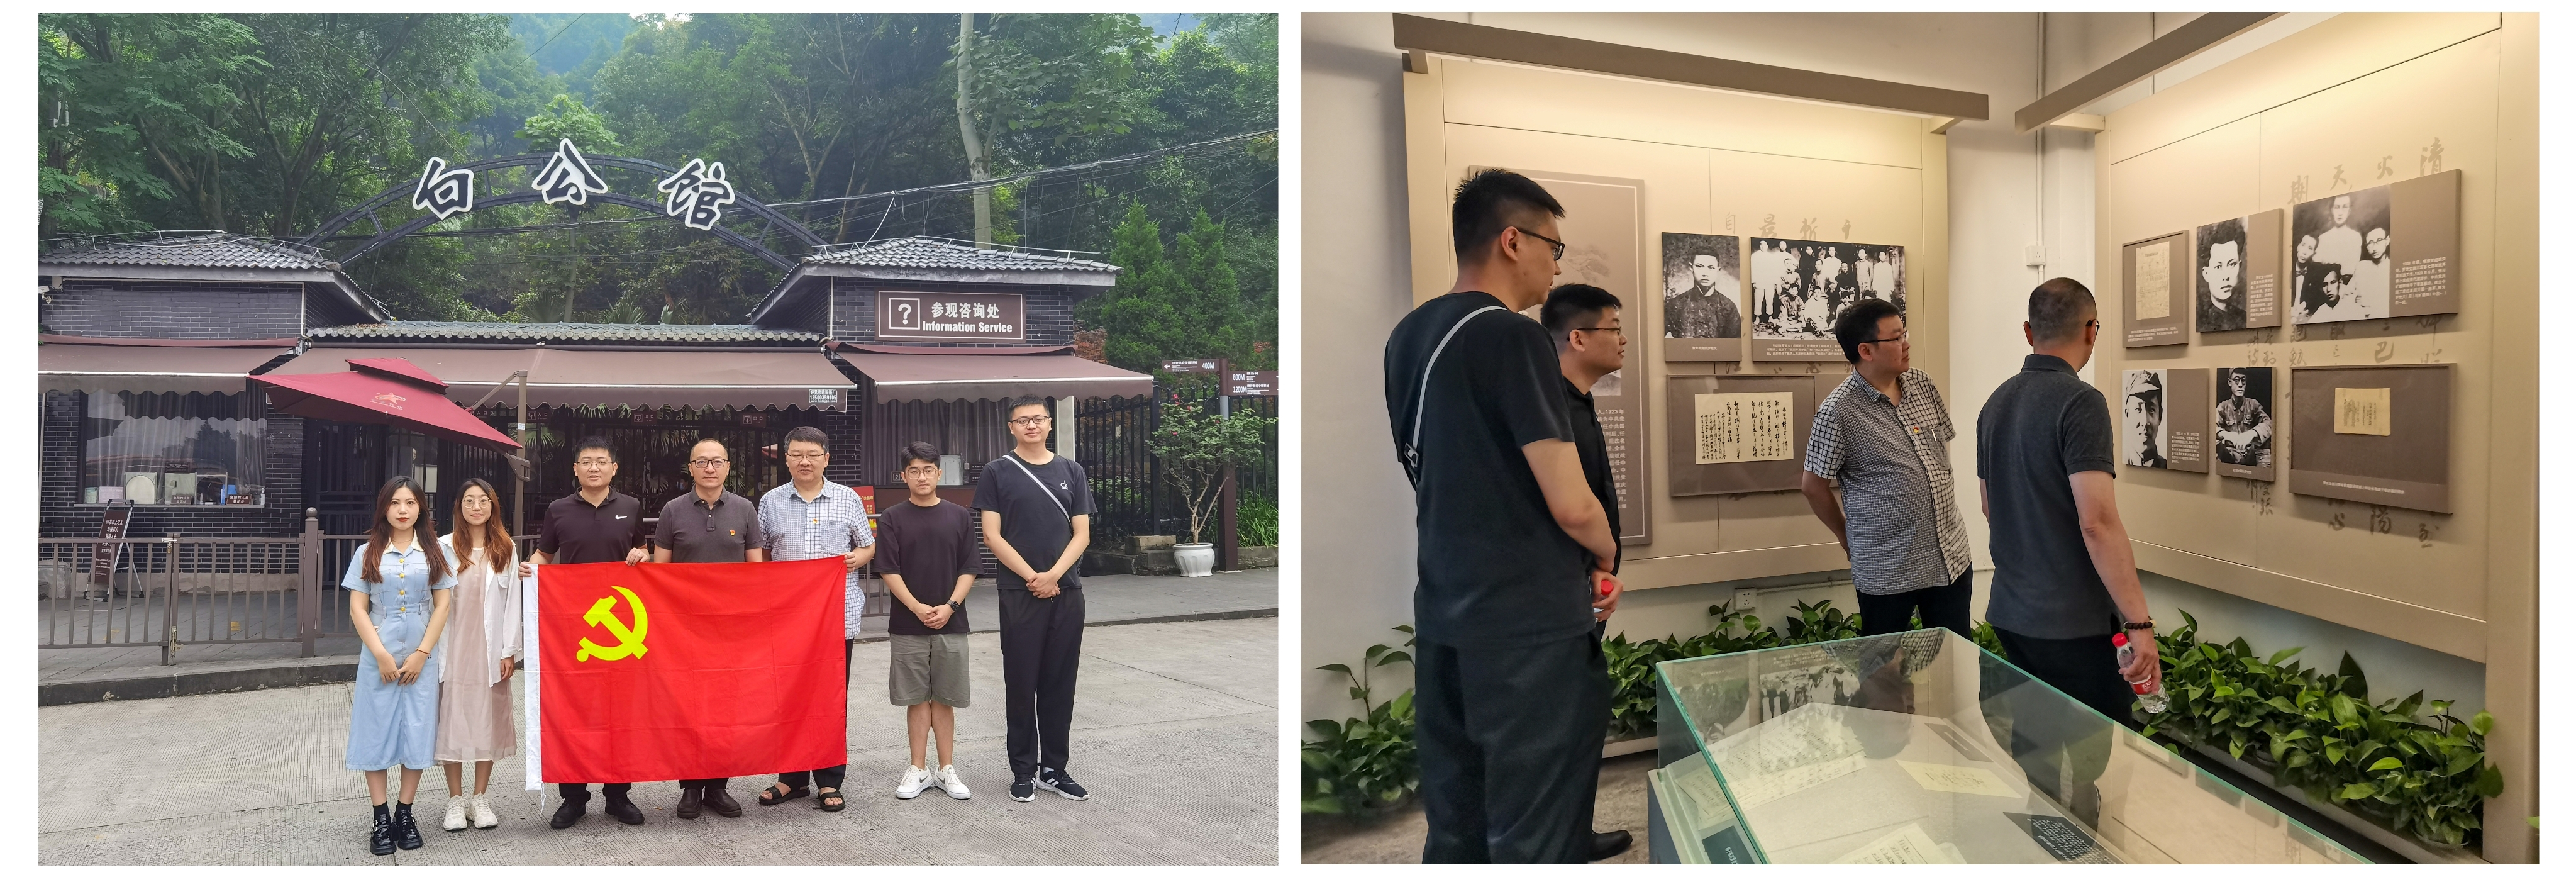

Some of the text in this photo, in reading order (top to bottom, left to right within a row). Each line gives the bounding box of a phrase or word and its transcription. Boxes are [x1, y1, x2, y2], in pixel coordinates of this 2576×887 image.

[413, 138, 735, 230] 白公馆
[931, 301, 999, 318] 参观咨询处
[922, 321, 1013, 333] Information Service
